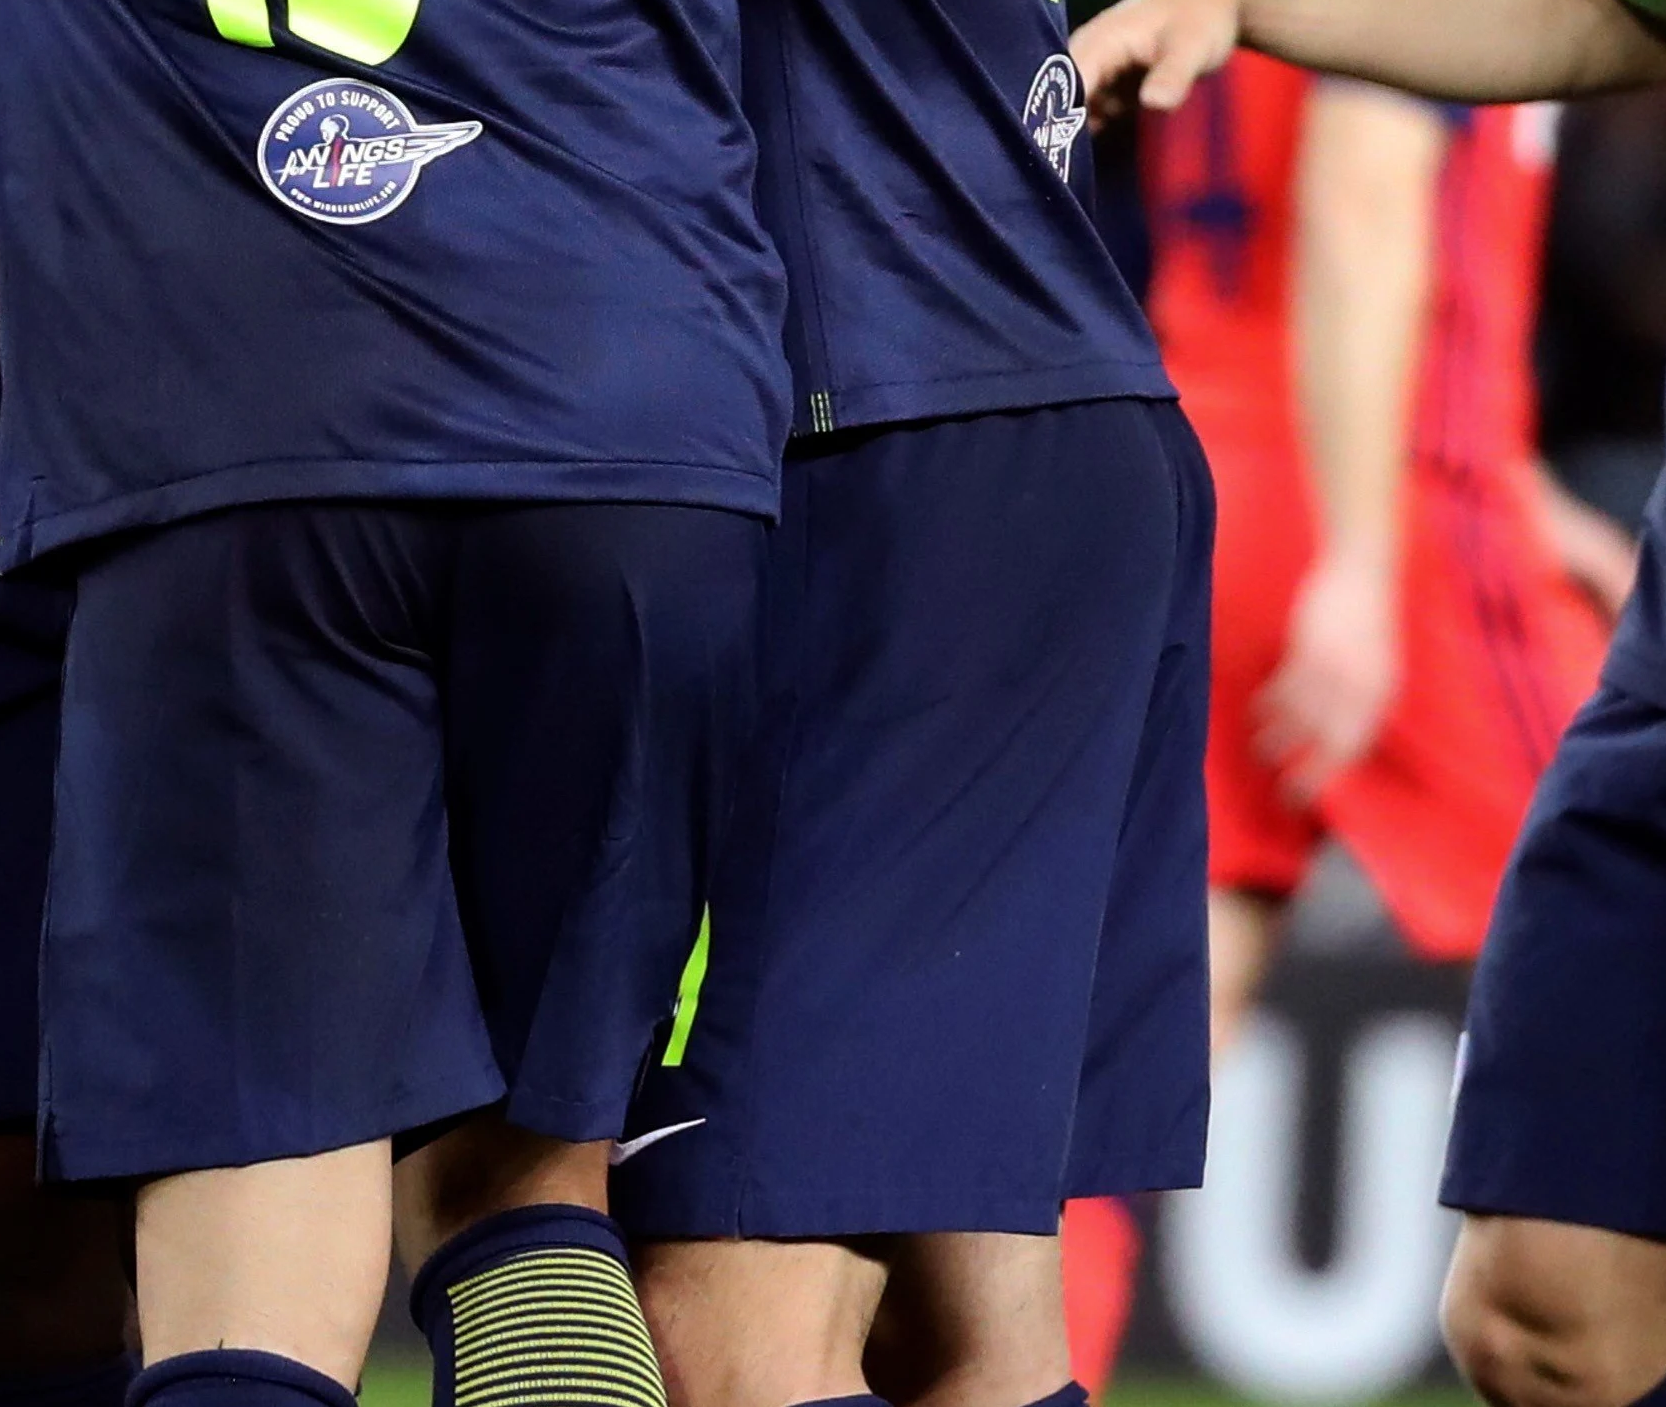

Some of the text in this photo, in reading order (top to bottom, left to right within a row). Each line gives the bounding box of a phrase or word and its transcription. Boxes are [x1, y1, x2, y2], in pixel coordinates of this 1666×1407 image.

[274, 90, 402, 143] PROUD TO SUPPORT
